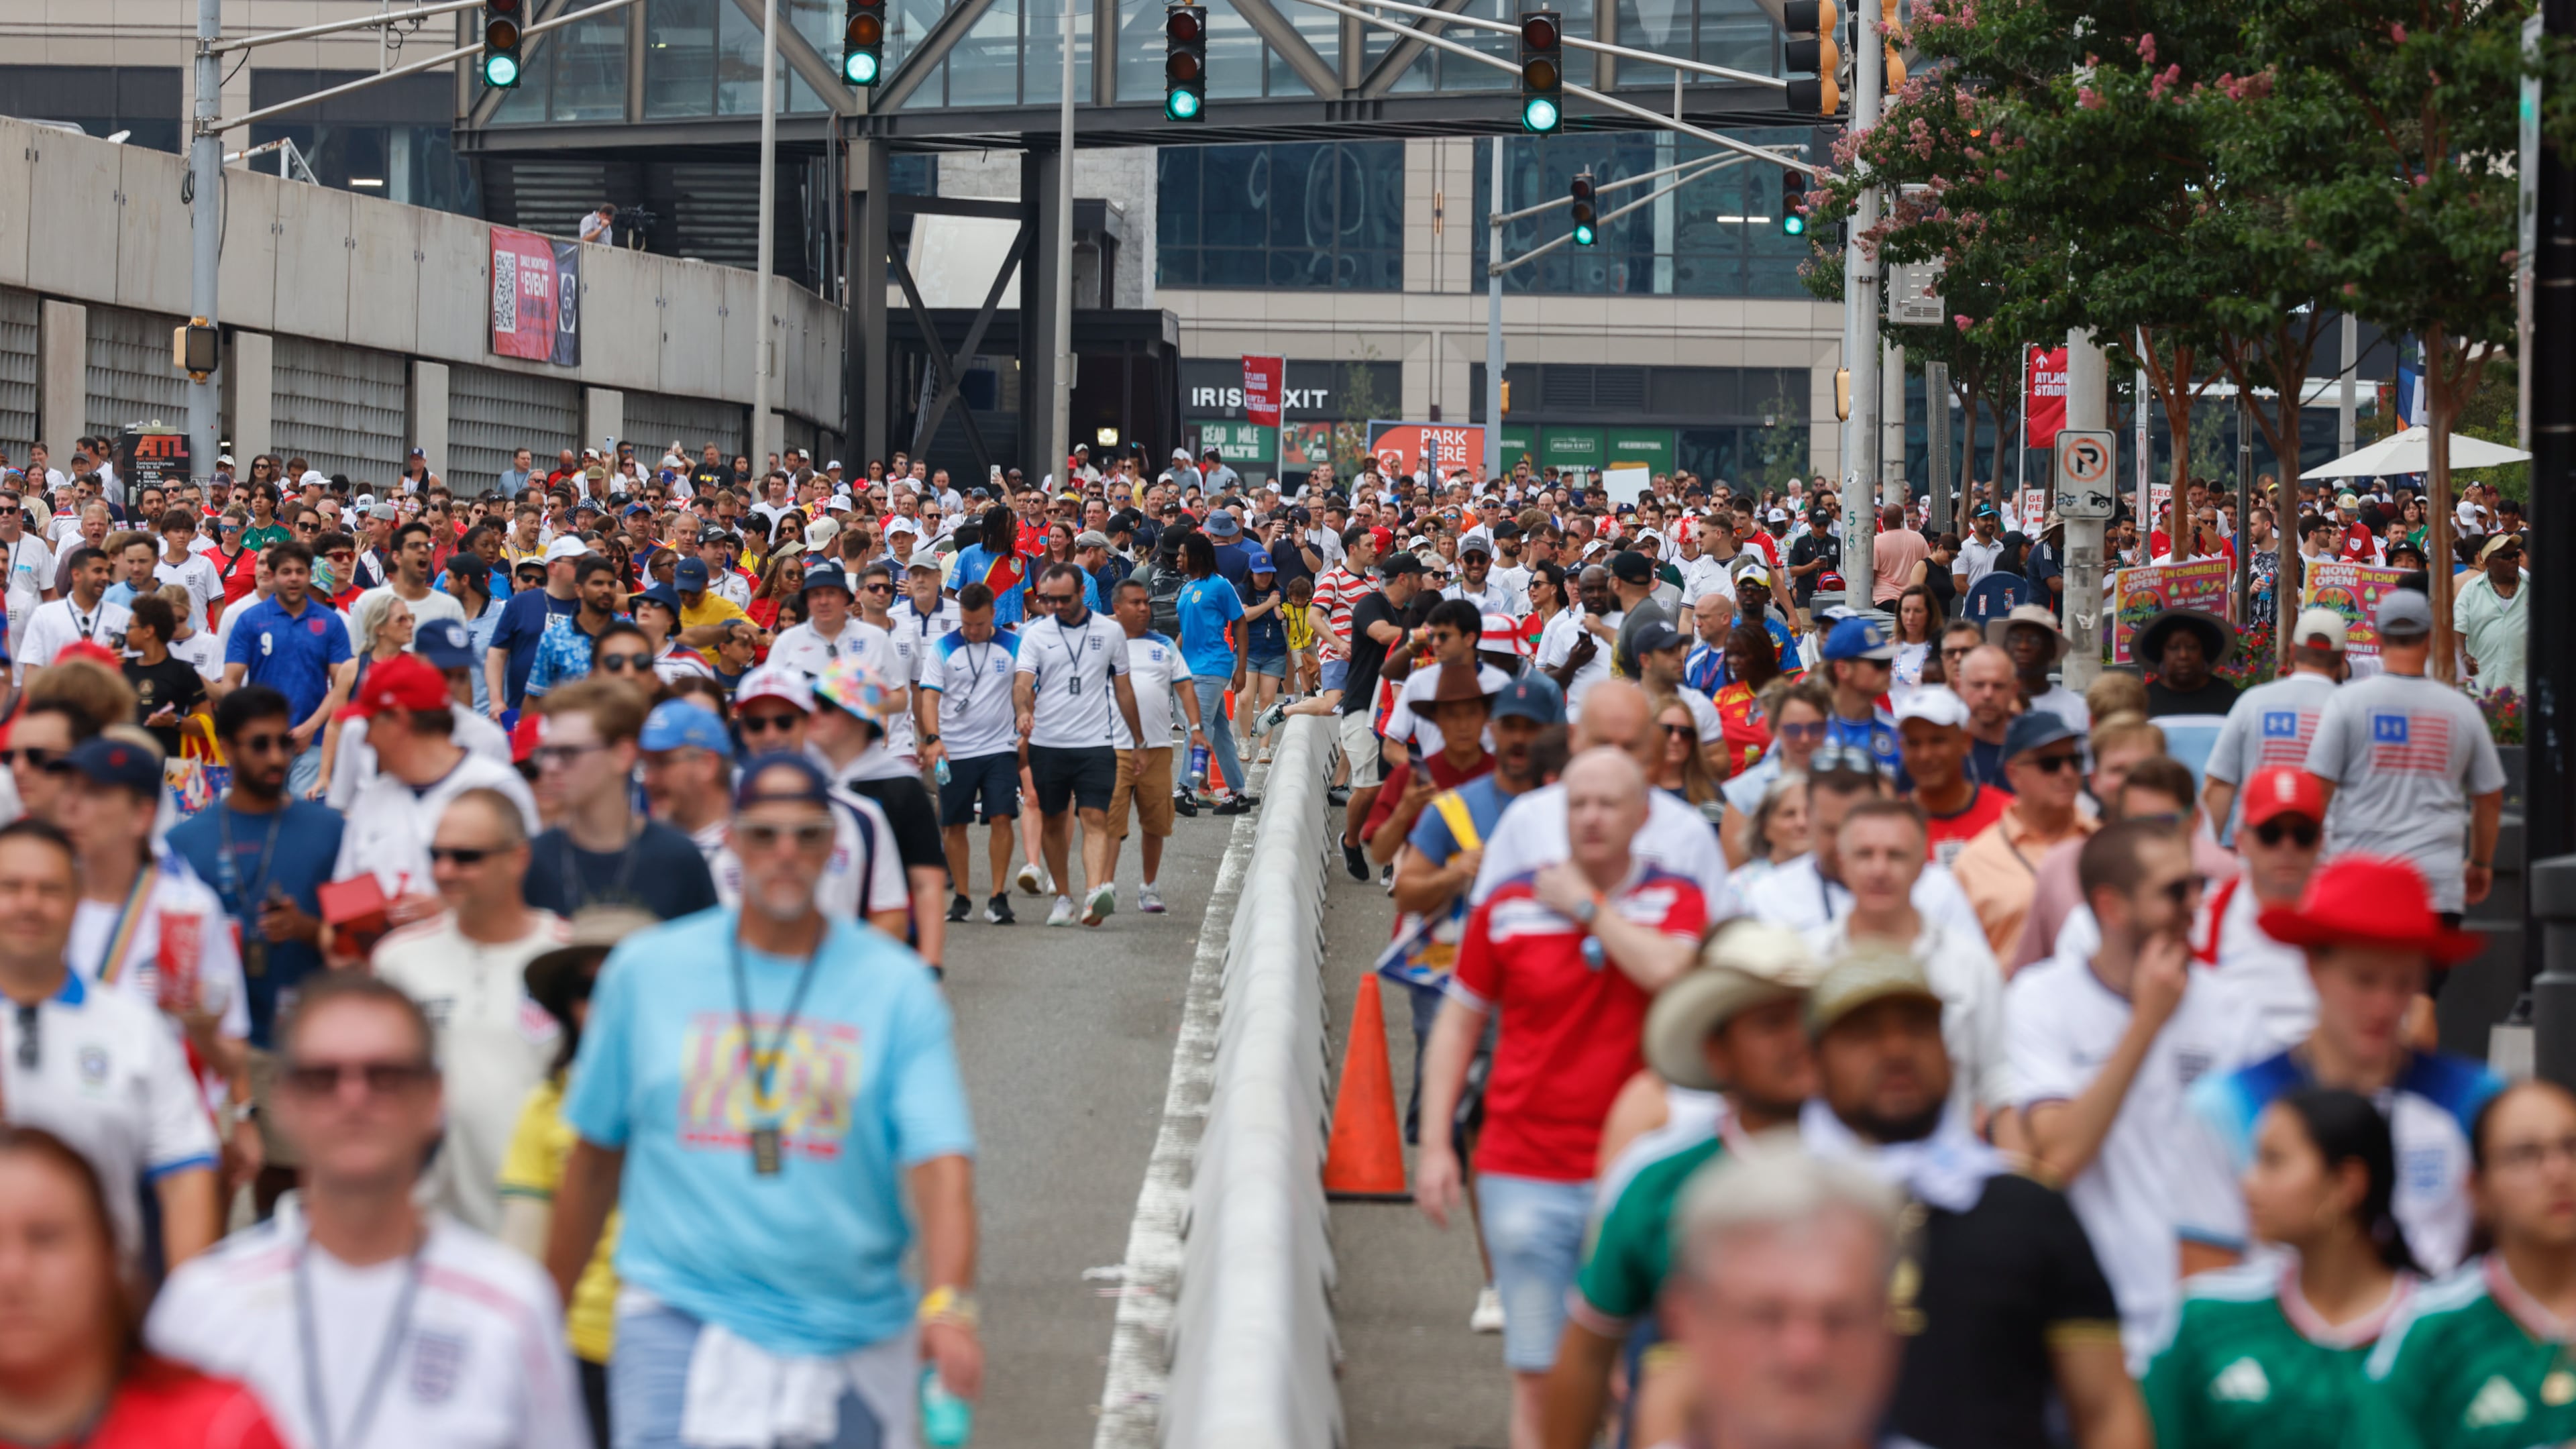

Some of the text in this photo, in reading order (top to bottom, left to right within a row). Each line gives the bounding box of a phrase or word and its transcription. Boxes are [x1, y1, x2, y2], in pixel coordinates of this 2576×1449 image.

[531, 256, 549, 271] MONTHLY
[525, 272, 549, 298] EVENT
[2035, 372, 2068, 384] ATLAN
[2034, 384, 2068, 396] STADI
[1192, 387, 1328, 409] IRIS XIT
[1202, 423, 1259, 444] CÉAD MÍLE
[1421, 429, 1467, 445] PARK
[134, 435, 189, 457] ATL
[2028, 494, 2043, 502] GE
[1849, 511, 1856, 527] 5
[1848, 533, 1856, 548] 6
[2128, 564, 2226, 582] NOW IN CHAMBLEE!
[2320, 566, 2400, 584] NOW IN CHA
[2124, 578, 2163, 592] OPEN!
[2315, 576, 2358, 586] OPEN!
[2188, 596, 2205, 604] Legal
[2206, 594, 2219, 602] THC
[260, 631, 273, 656] 9
[2120, 634, 2132, 643] TU
